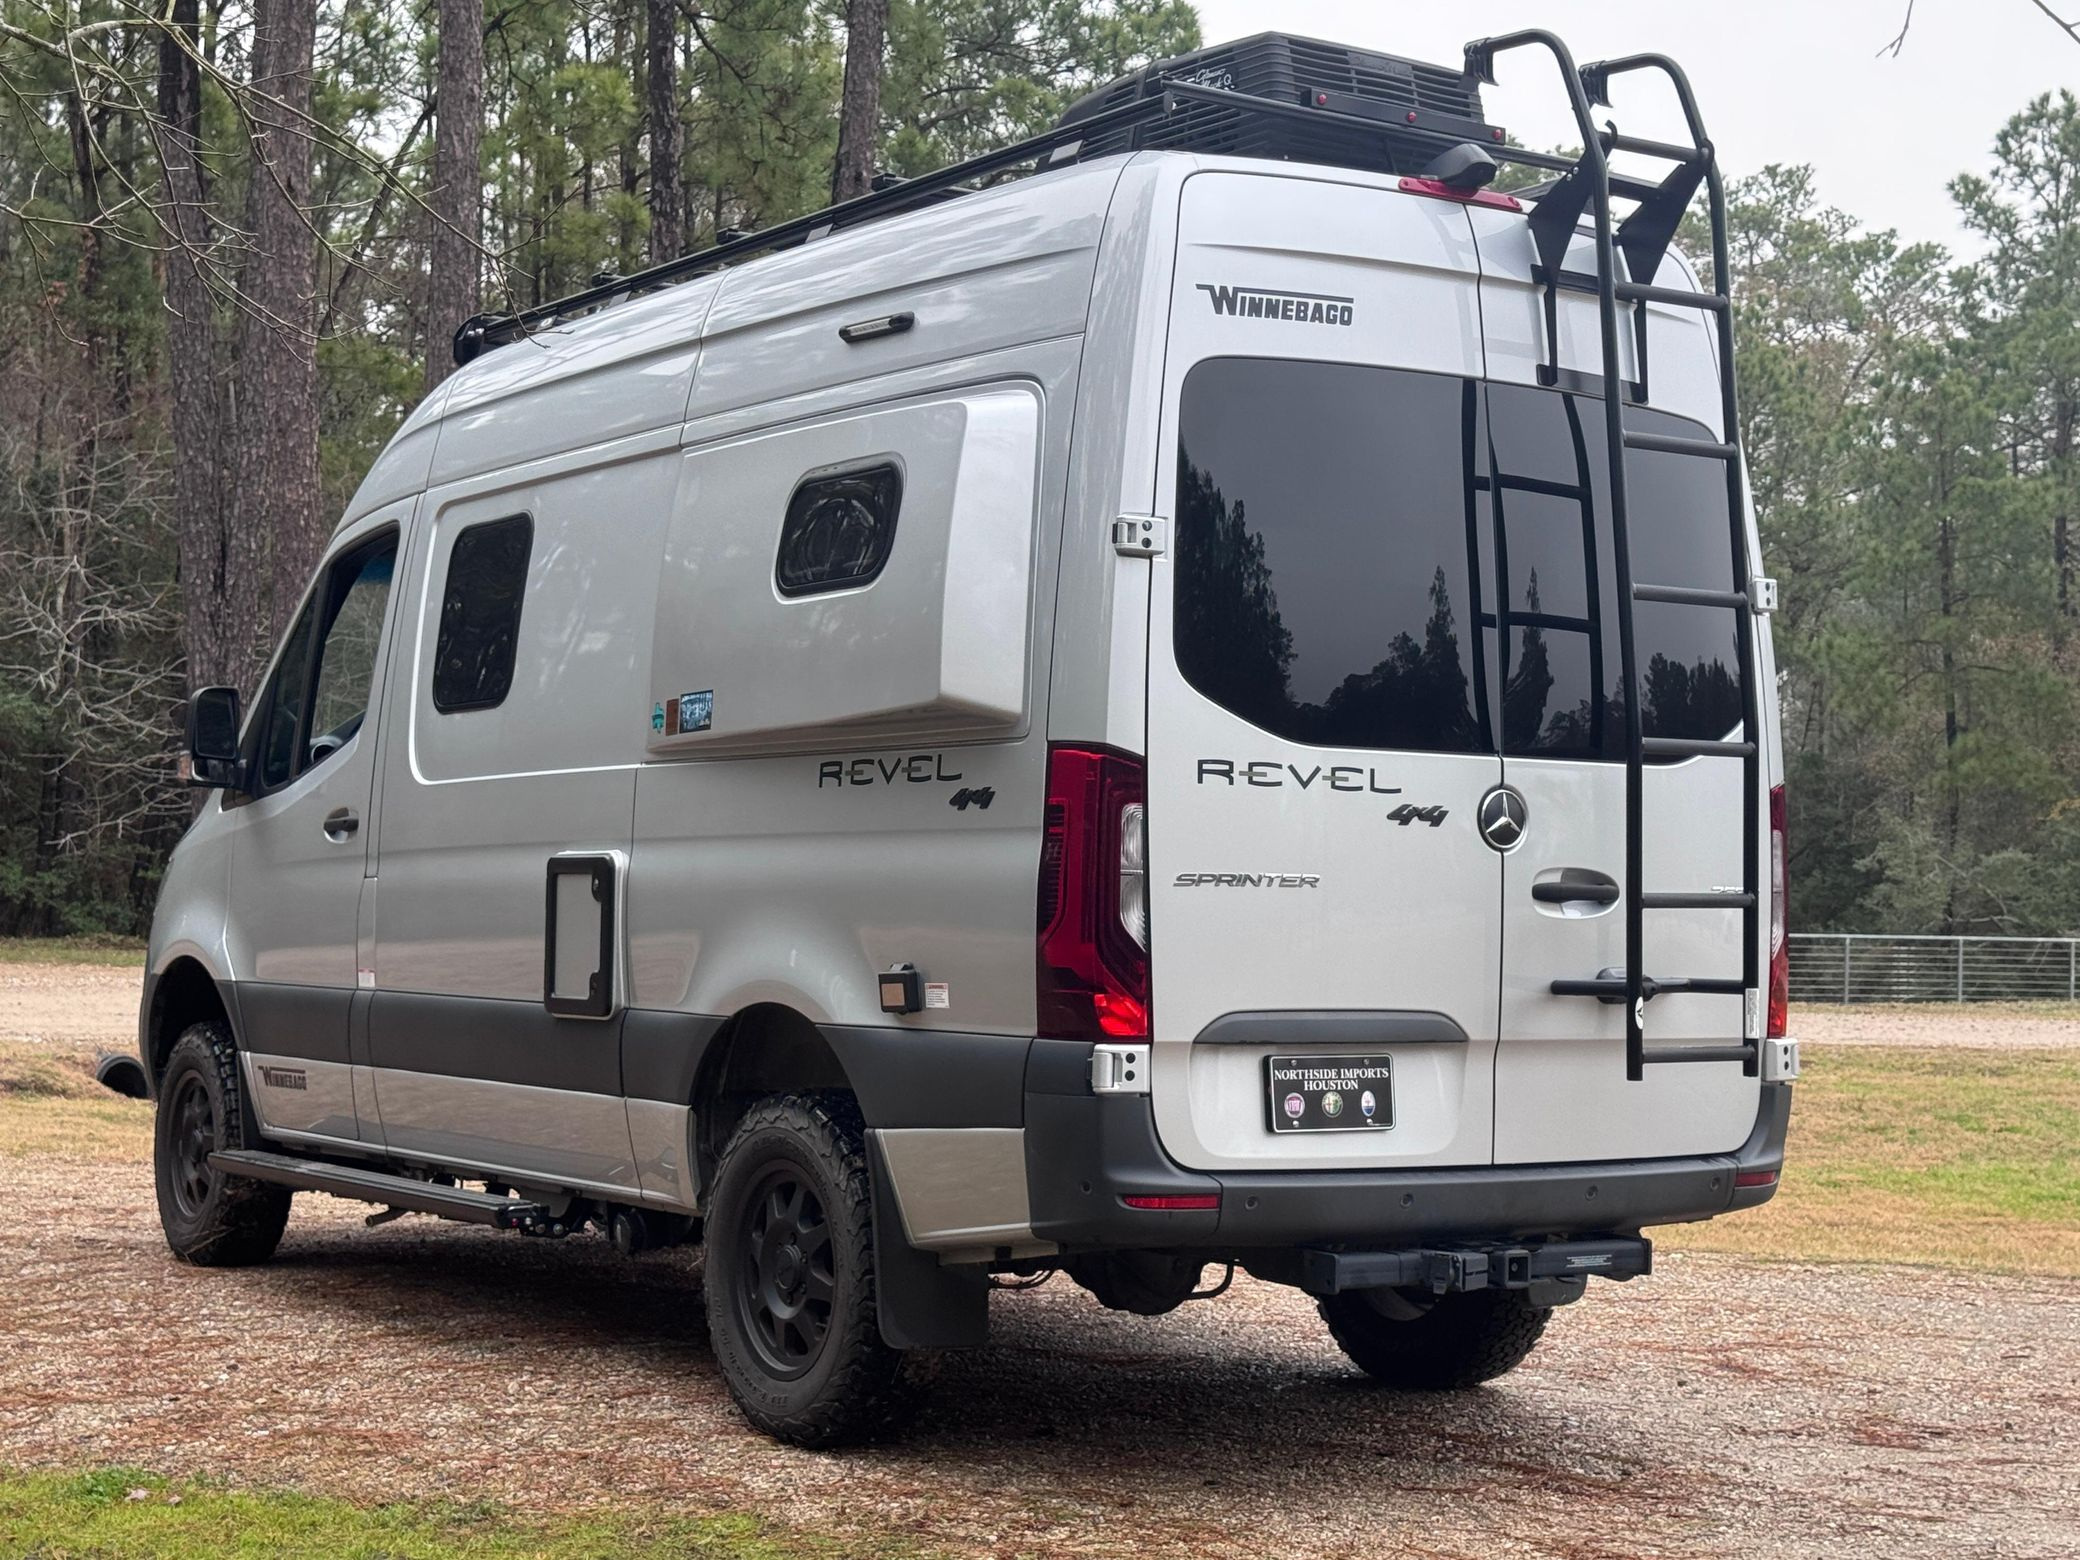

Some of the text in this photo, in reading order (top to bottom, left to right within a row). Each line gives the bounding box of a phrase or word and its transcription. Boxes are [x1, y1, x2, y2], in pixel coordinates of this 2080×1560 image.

[1195, 283, 1355, 326] WINNEBAGO
[818, 753, 962, 789] REVEL
[1197, 759, 1402, 794] REVEL
[1386, 803, 1450, 827] 4x4
[1172, 872, 1321, 889] SPRINTER
[1274, 1067, 1390, 1081] NORTHSIDE IMPORTS
[1303, 1079, 1359, 1091] HOUSTON
